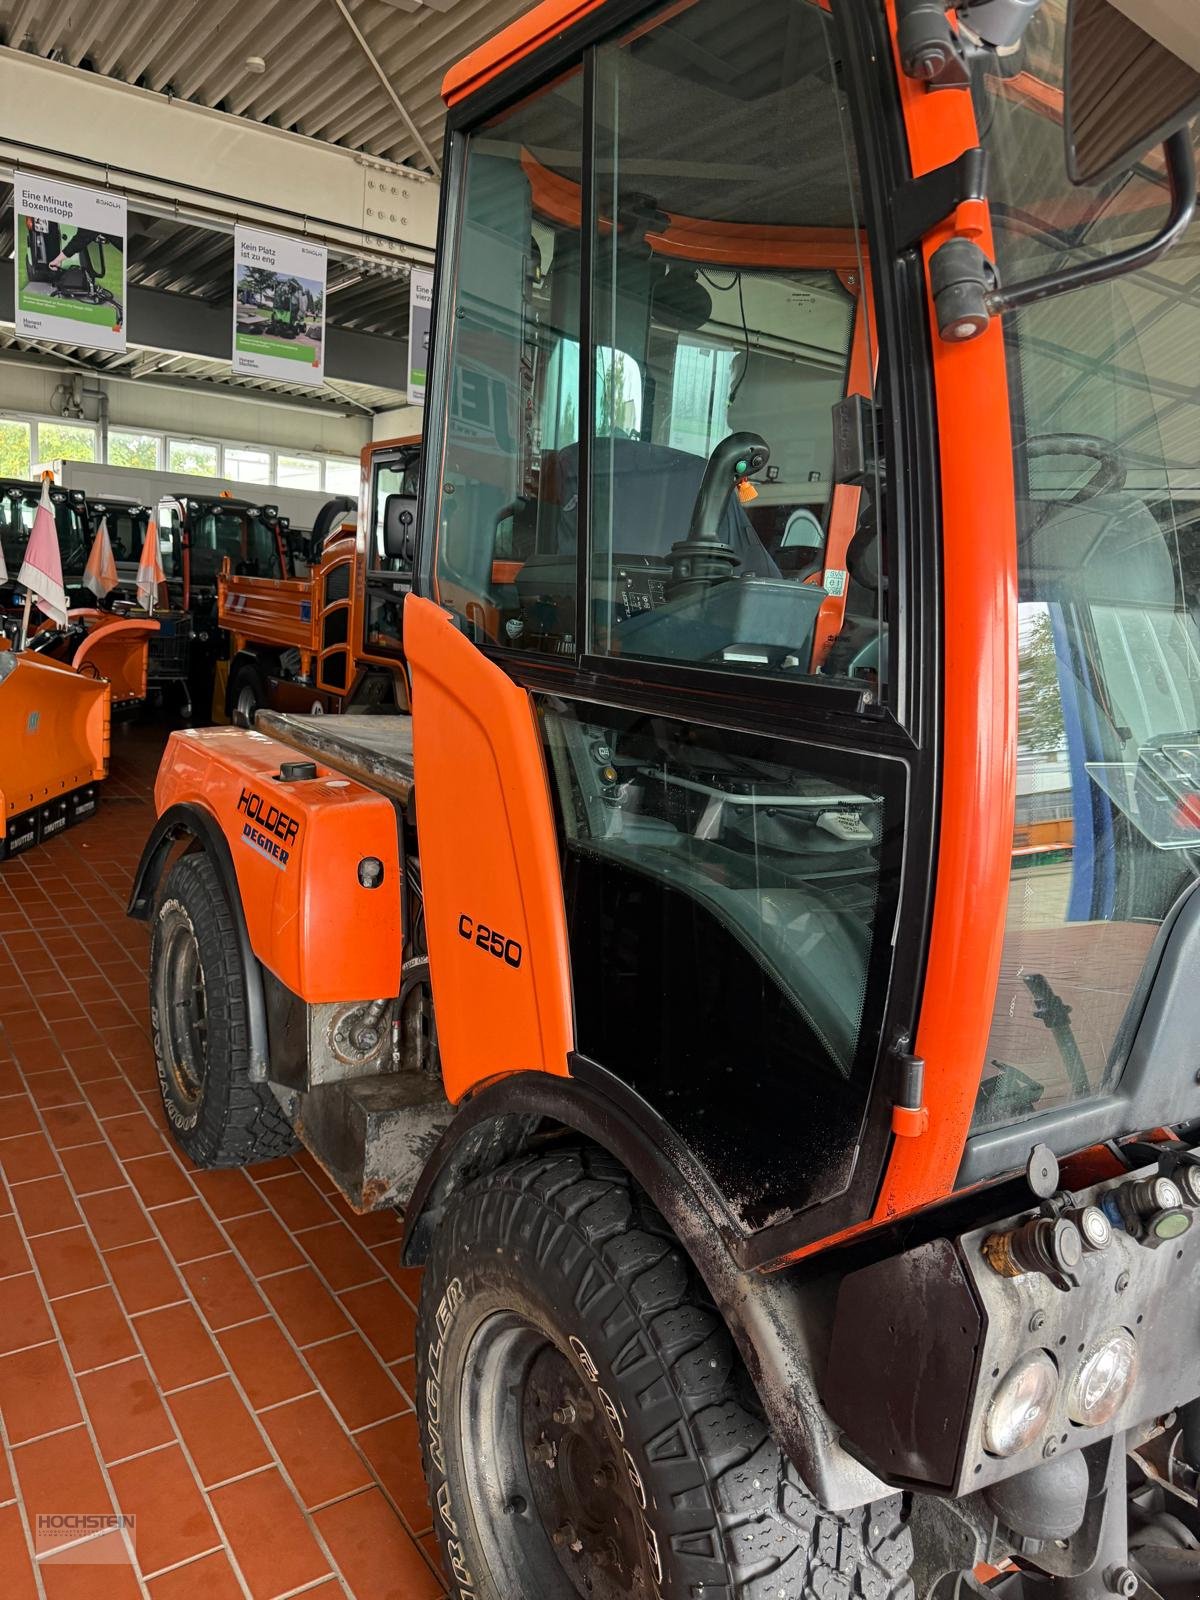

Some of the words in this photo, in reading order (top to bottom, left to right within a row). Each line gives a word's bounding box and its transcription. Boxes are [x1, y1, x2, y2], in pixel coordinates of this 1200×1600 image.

[22, 190, 41, 201] Eine
[43, 194, 73, 208] Minute
[22, 199, 73, 218] Boxenstopp
[241, 241, 257, 252] Kein
[258, 245, 276, 256] Platz
[241, 249, 250, 259] ist
[251, 252, 261, 260] zu
[261, 256, 276, 265] eng
[237, 787, 299, 846] HOLDER
[243, 823, 289, 864] DEGNER
[458, 914, 473, 940] C
[476, 924, 522, 969] 250
